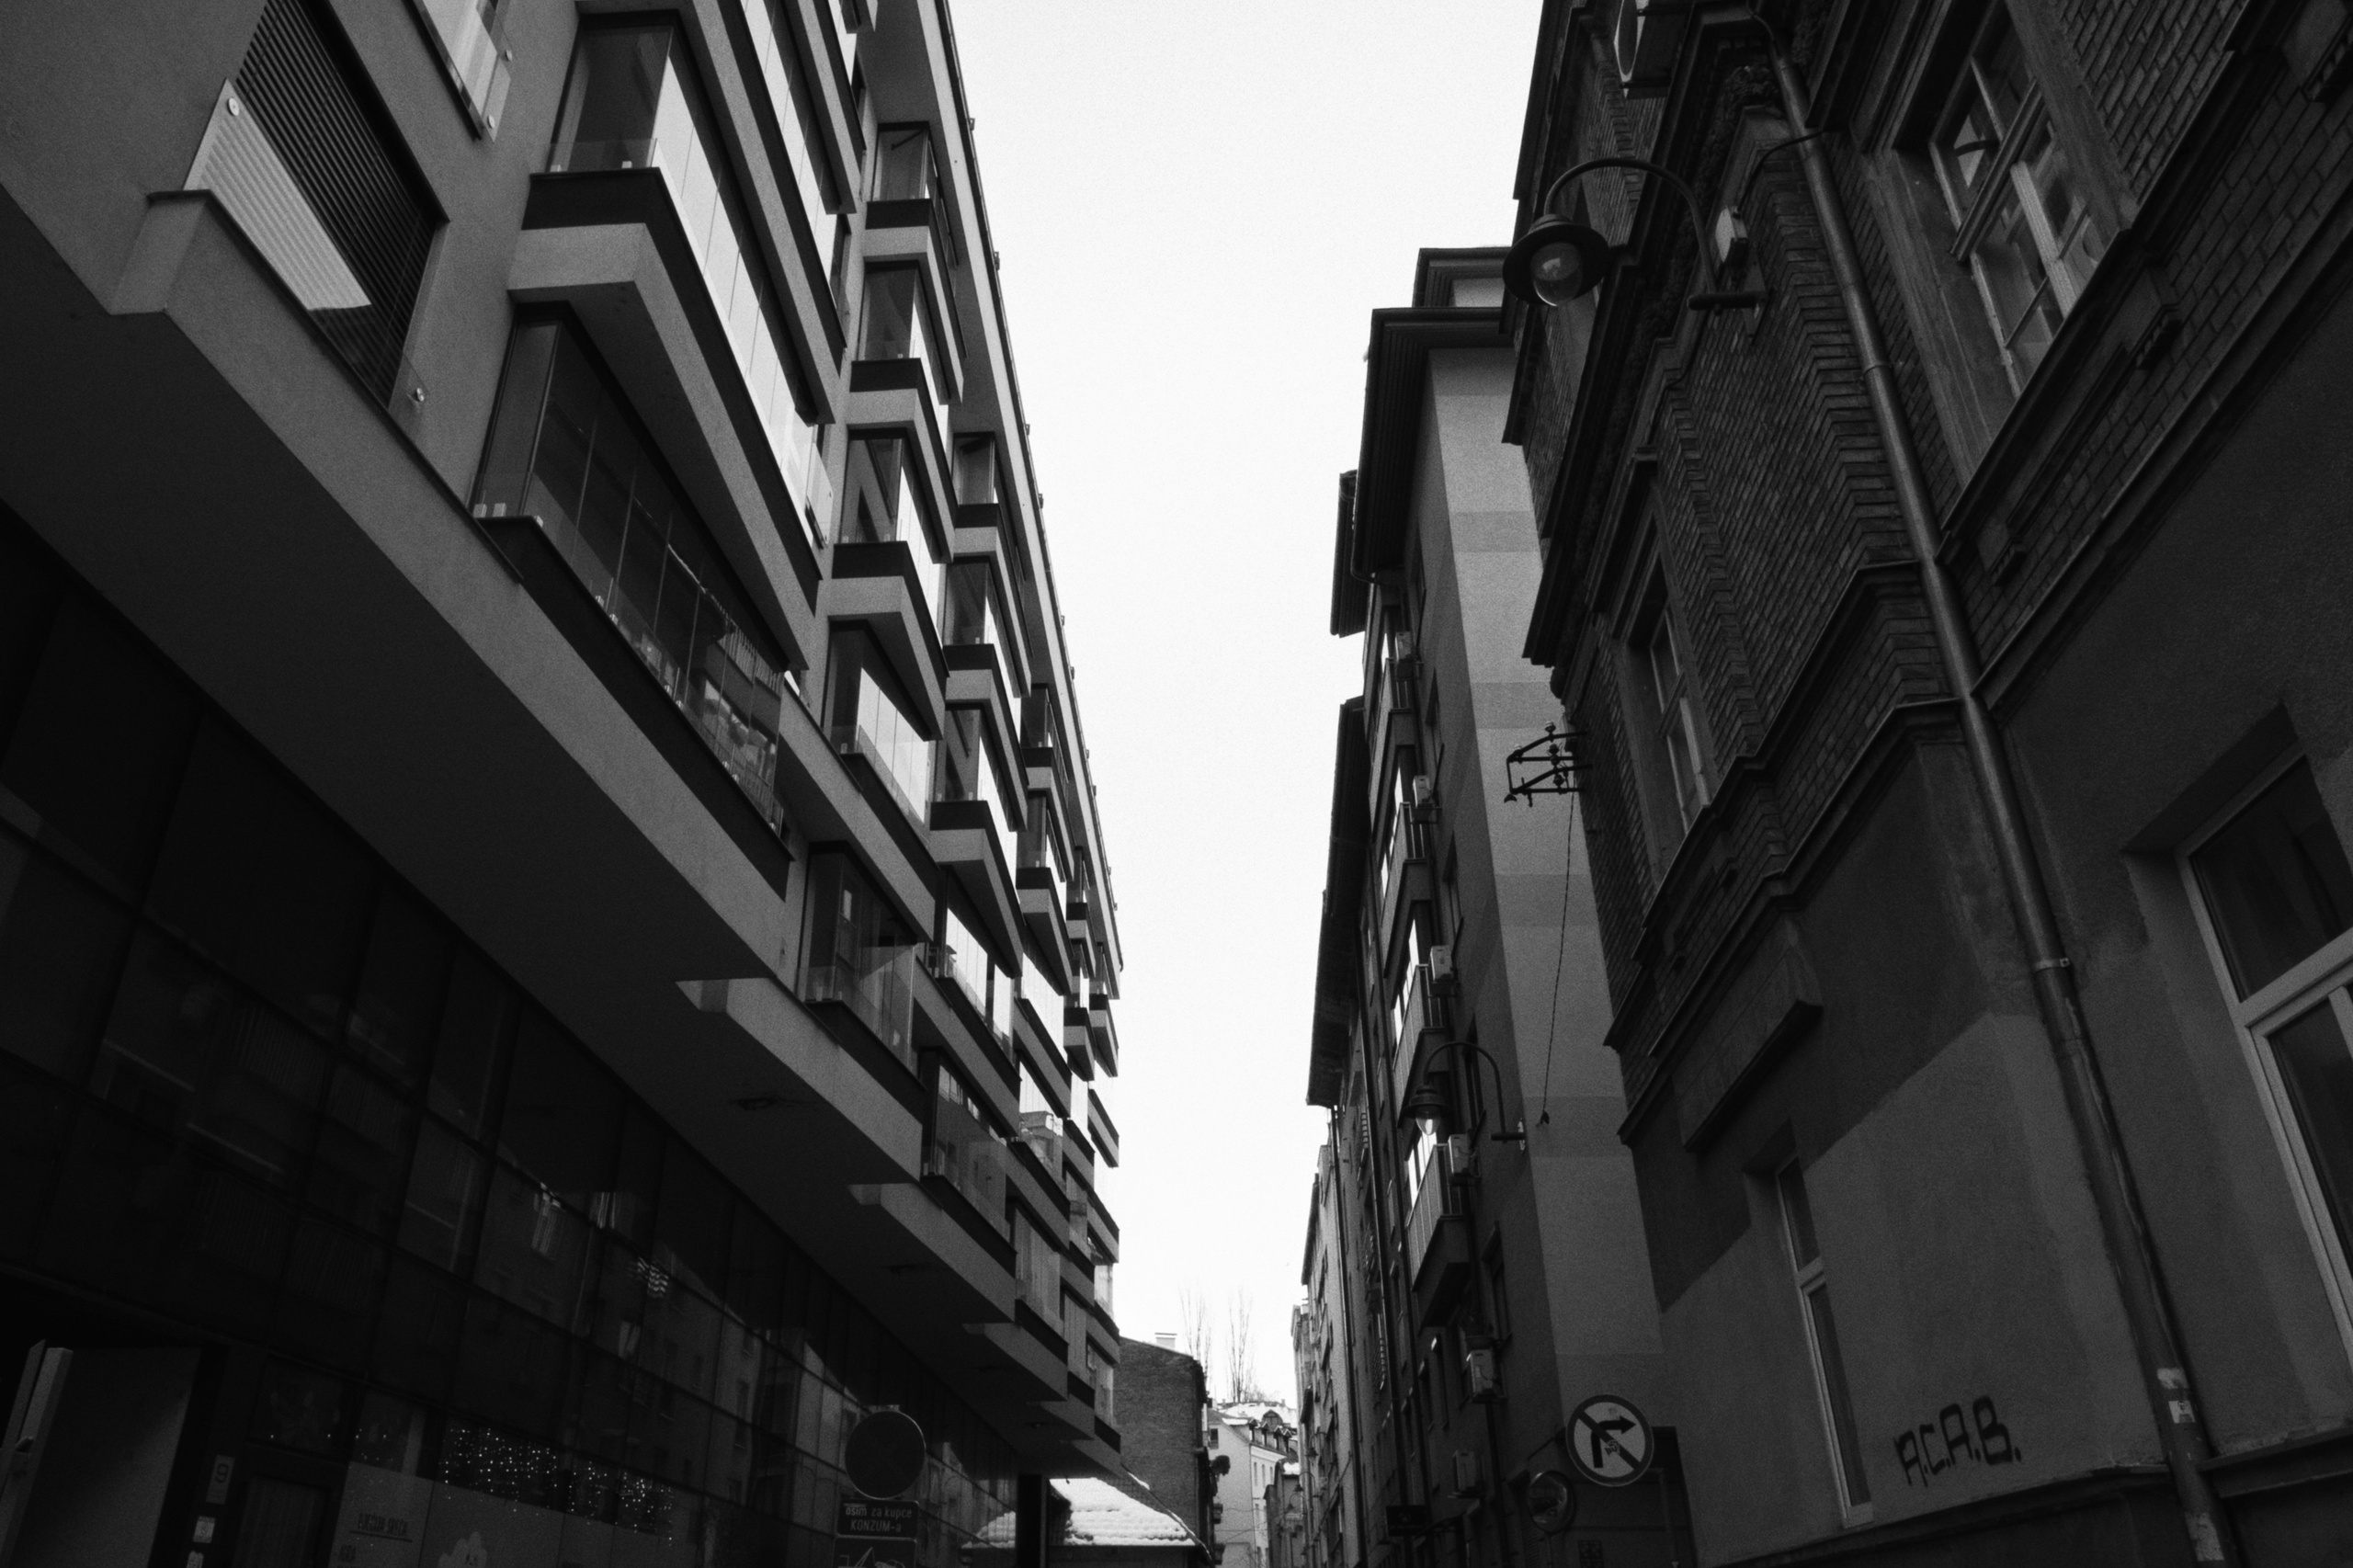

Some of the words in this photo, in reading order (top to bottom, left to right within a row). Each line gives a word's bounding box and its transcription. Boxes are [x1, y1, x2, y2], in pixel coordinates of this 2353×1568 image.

[871, 1508, 882, 1517] za
[884, 1506, 912, 1520] kupce
[850, 1518, 902, 1532] KONZUM-a
